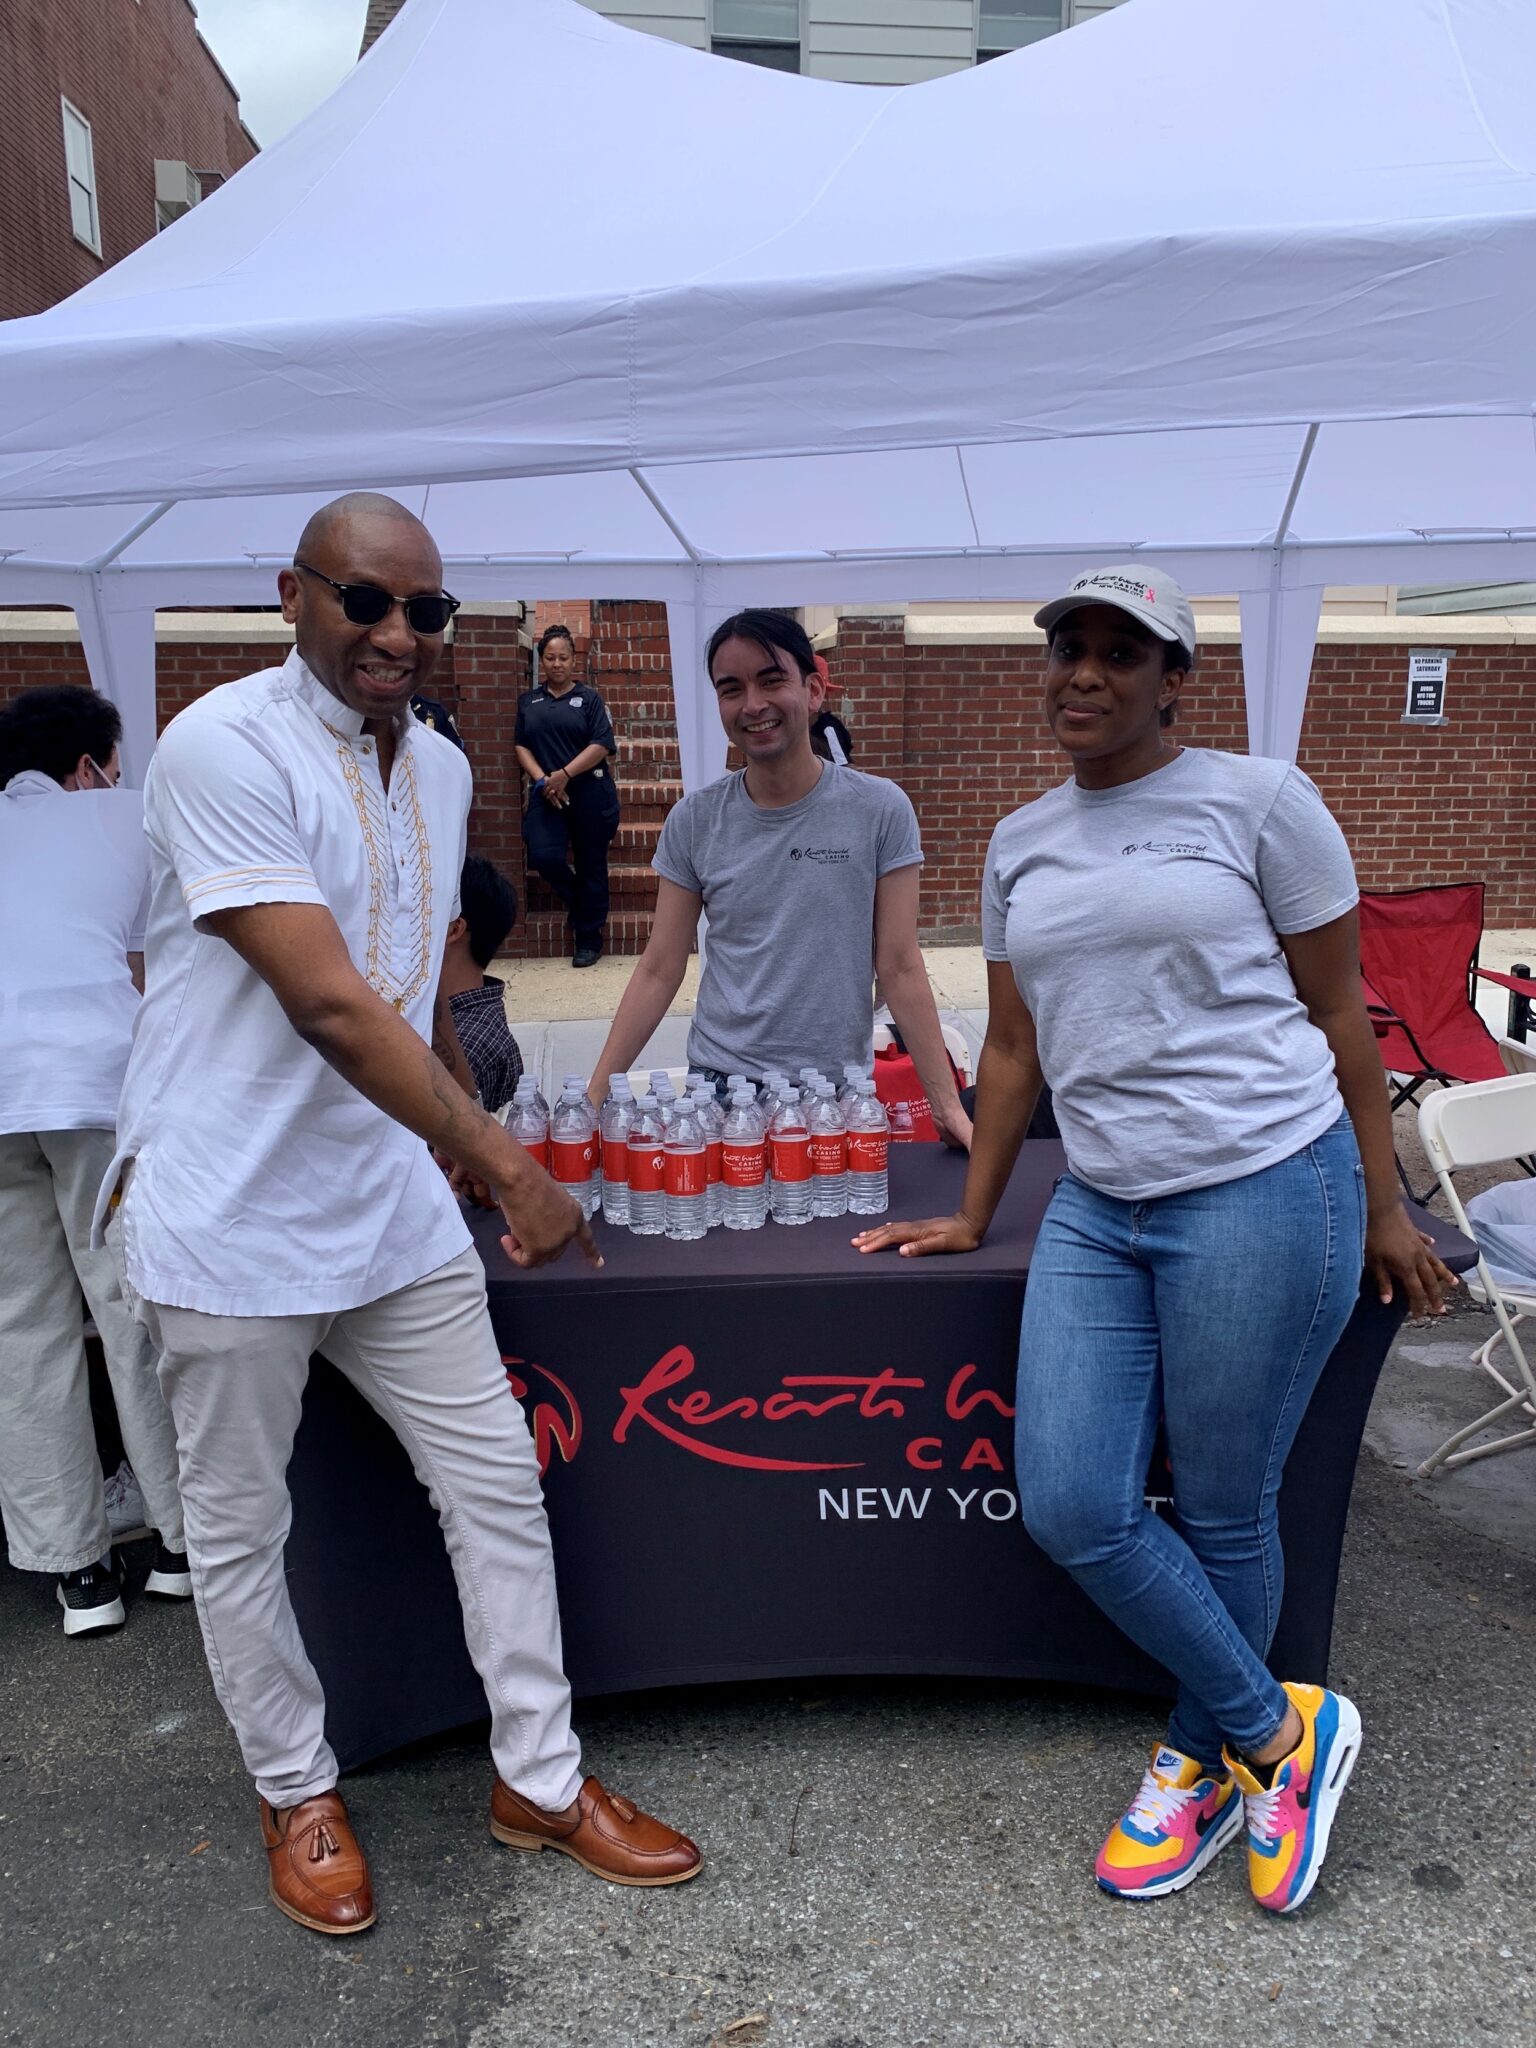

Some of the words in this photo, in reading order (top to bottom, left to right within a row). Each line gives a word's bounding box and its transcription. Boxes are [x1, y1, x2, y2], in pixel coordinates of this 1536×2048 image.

[1113, 581, 1144, 594] CASINO
[1114, 585, 1129, 593] YORK
[1130, 590, 1144, 598] CITY
[907, 1103, 932, 1114] CASINO
[818, 1487, 932, 1520] NEW
[946, 1487, 1017, 1522] YO
[1160, 1752, 1181, 1765] NIKE
